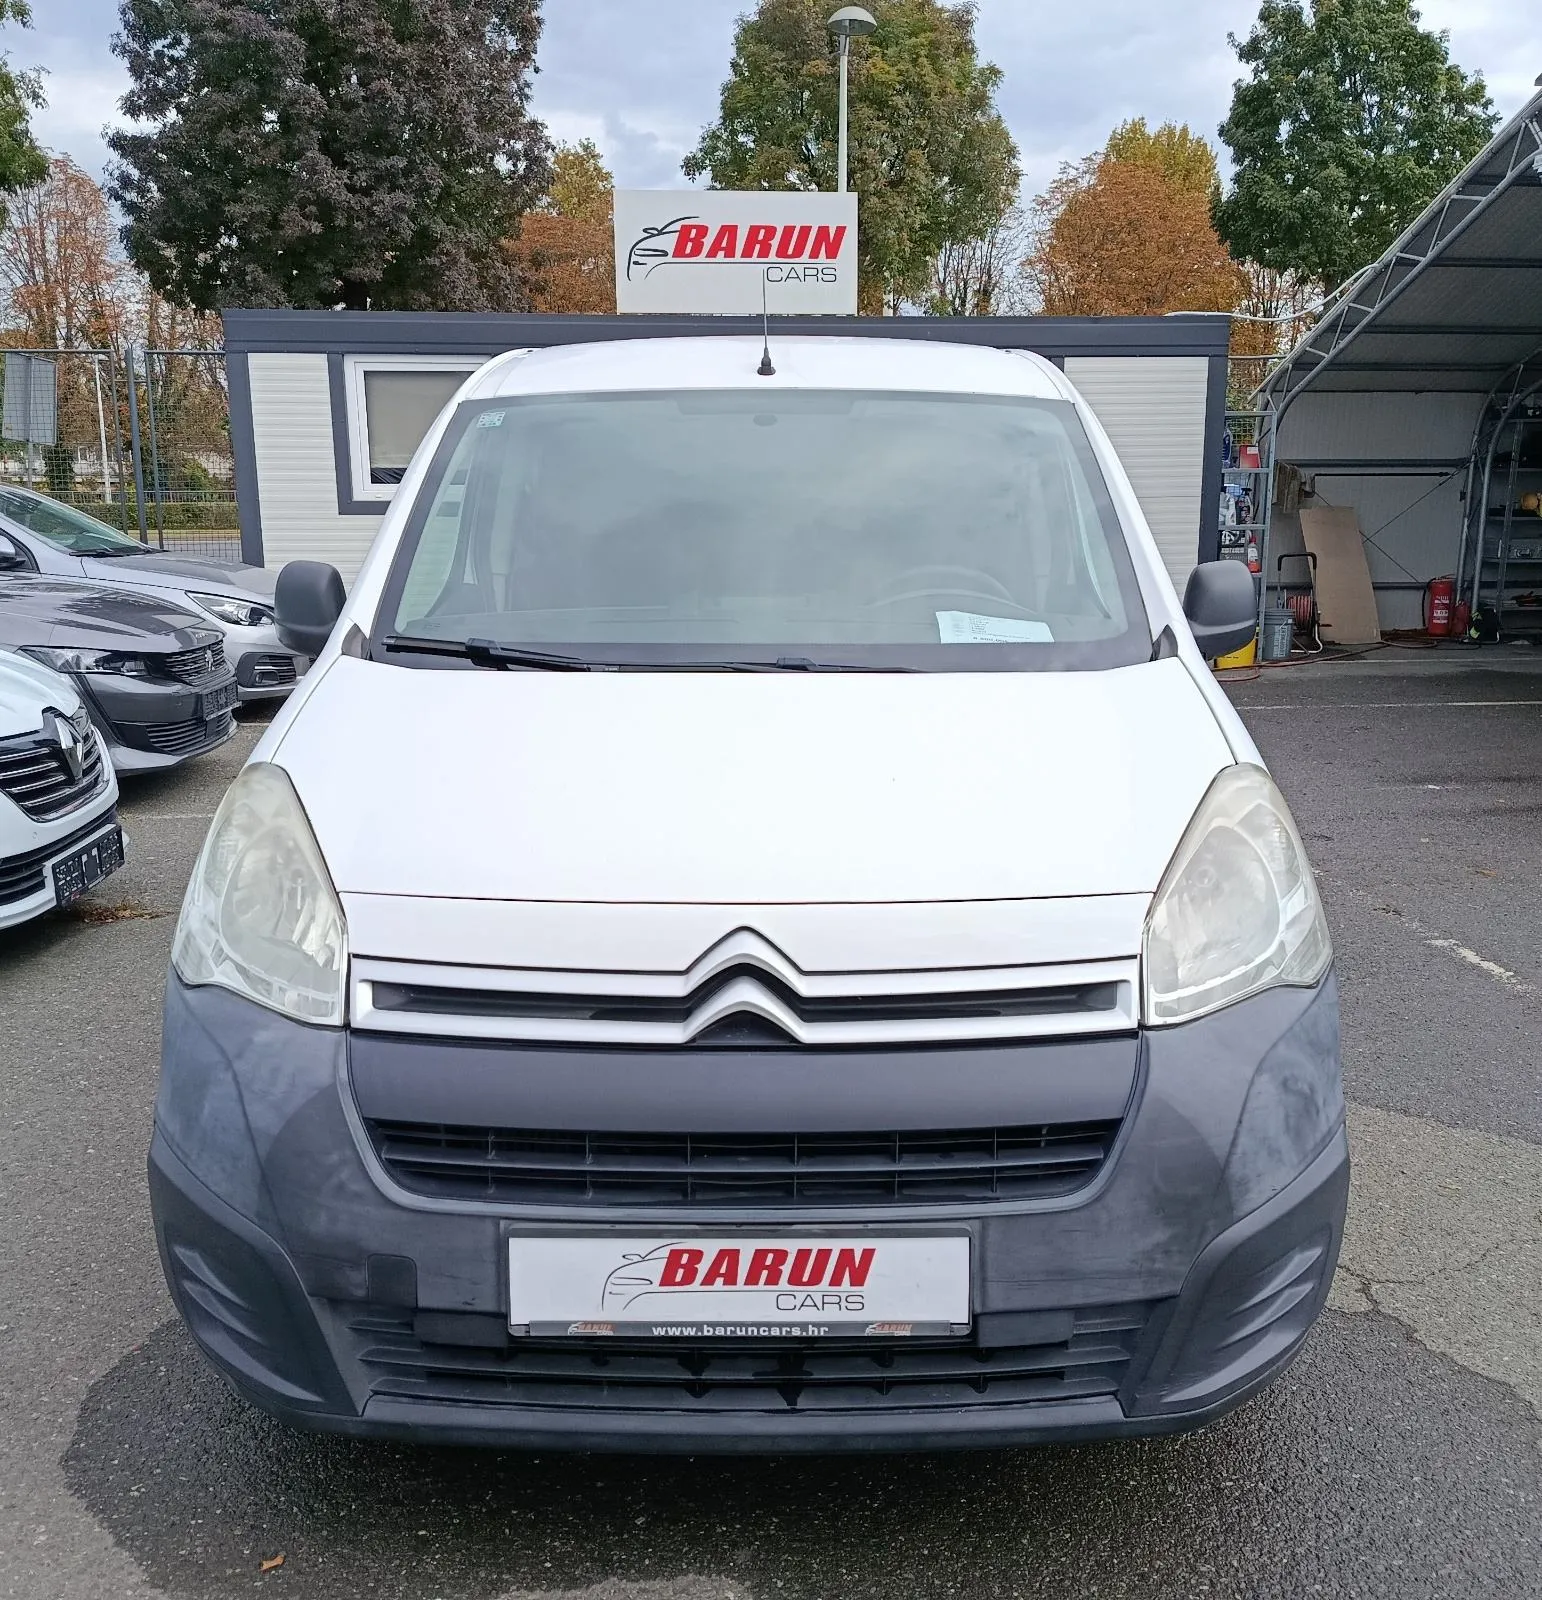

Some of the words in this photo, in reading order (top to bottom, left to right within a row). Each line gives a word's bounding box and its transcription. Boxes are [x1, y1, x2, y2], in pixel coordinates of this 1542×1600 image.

[671, 224, 847, 260] BARUN
[766, 266, 837, 283] CARS
[659, 1248, 876, 1287] BARUN
[776, 1293, 864, 1311] CARS
[652, 1324, 829, 1336] www.baruncars.hr
